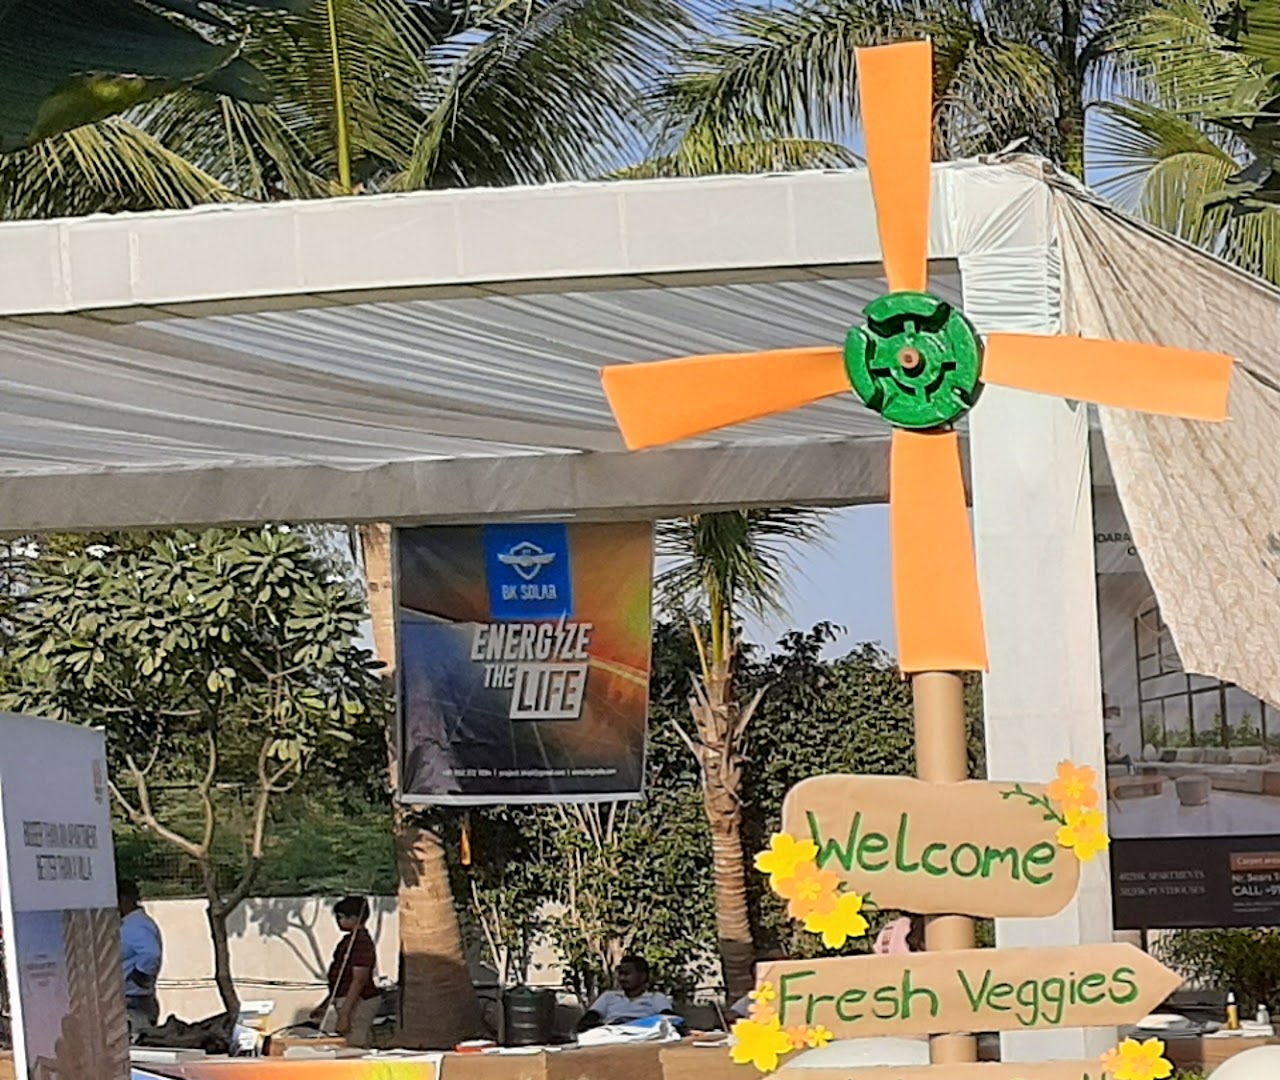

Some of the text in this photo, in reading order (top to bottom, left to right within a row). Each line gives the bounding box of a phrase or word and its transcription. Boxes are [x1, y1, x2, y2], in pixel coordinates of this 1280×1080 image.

[502, 584, 557, 601] BK SOLAR
[470, 610, 593, 663] ENERGIZE
[483, 664, 582, 714] THE LIFE
[805, 810, 1056, 885] Welcome
[778, 965, 1139, 1026] Fresh Veggies
